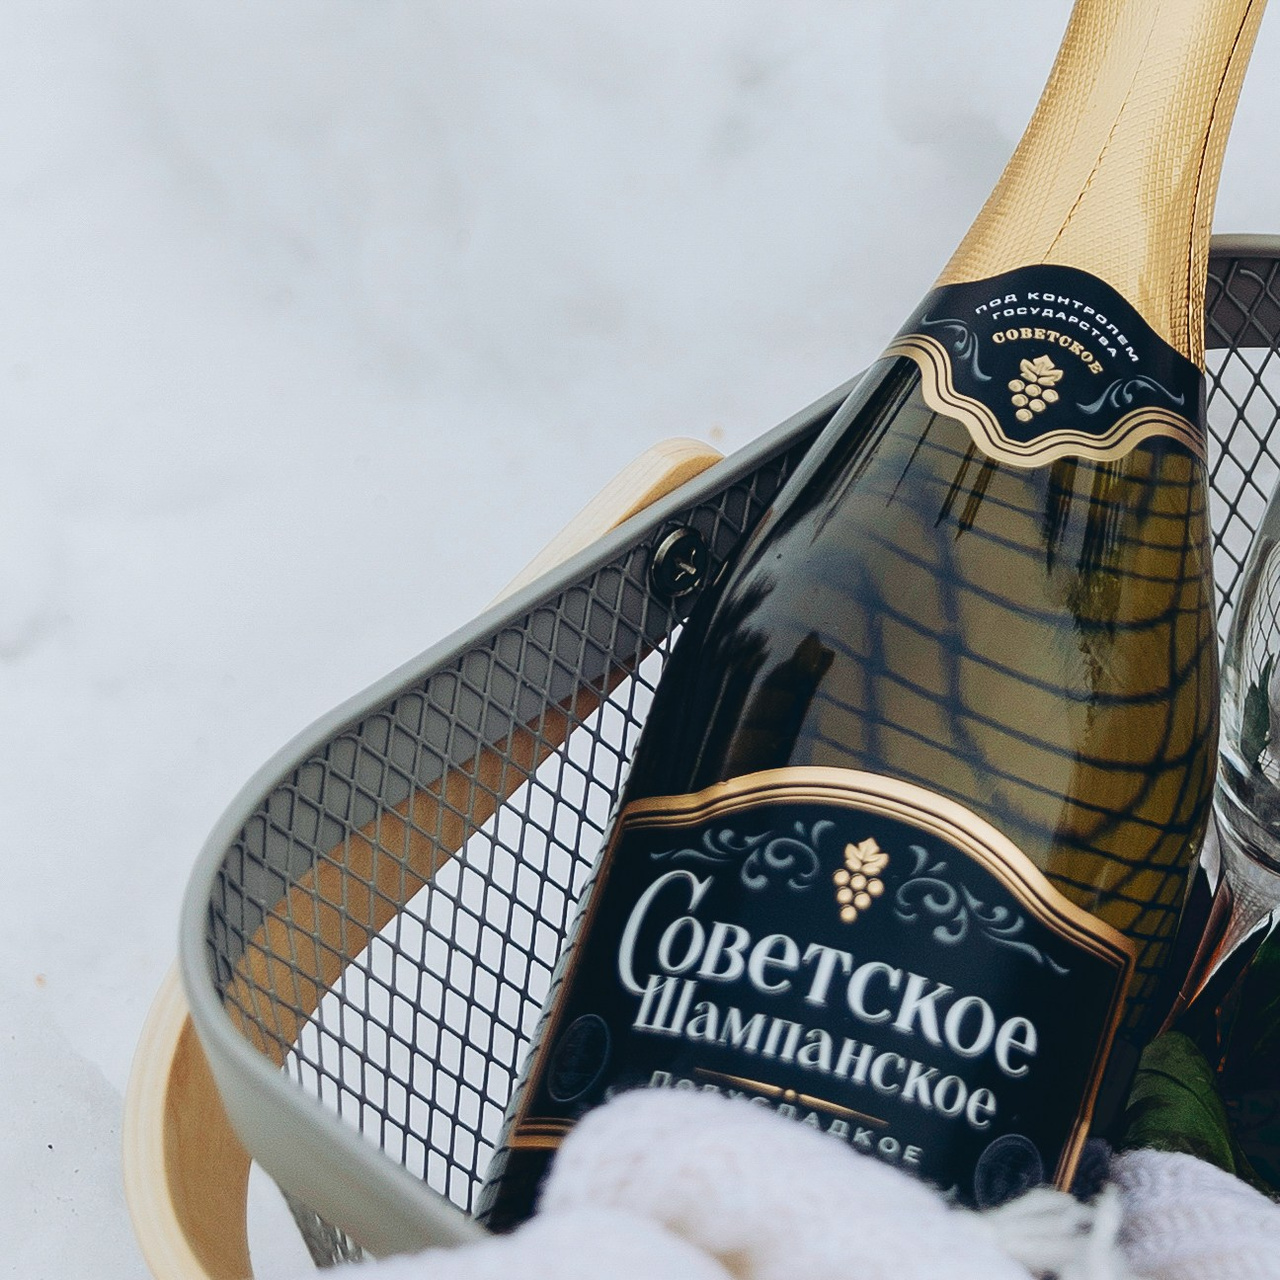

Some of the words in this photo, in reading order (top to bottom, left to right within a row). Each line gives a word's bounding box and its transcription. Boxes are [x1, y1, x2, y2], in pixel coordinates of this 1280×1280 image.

[975, 293, 1018, 314] ПОД
[1027, 292, 1140, 362] КОНТРОЛЕМ
[992, 307, 1118, 358] ГОСУДАРСТВА
[992, 328, 1104, 374] СОВЕТСКОЕ
[618, 869, 1039, 1078] Советское
[631, 974, 999, 1130] Шампанское
